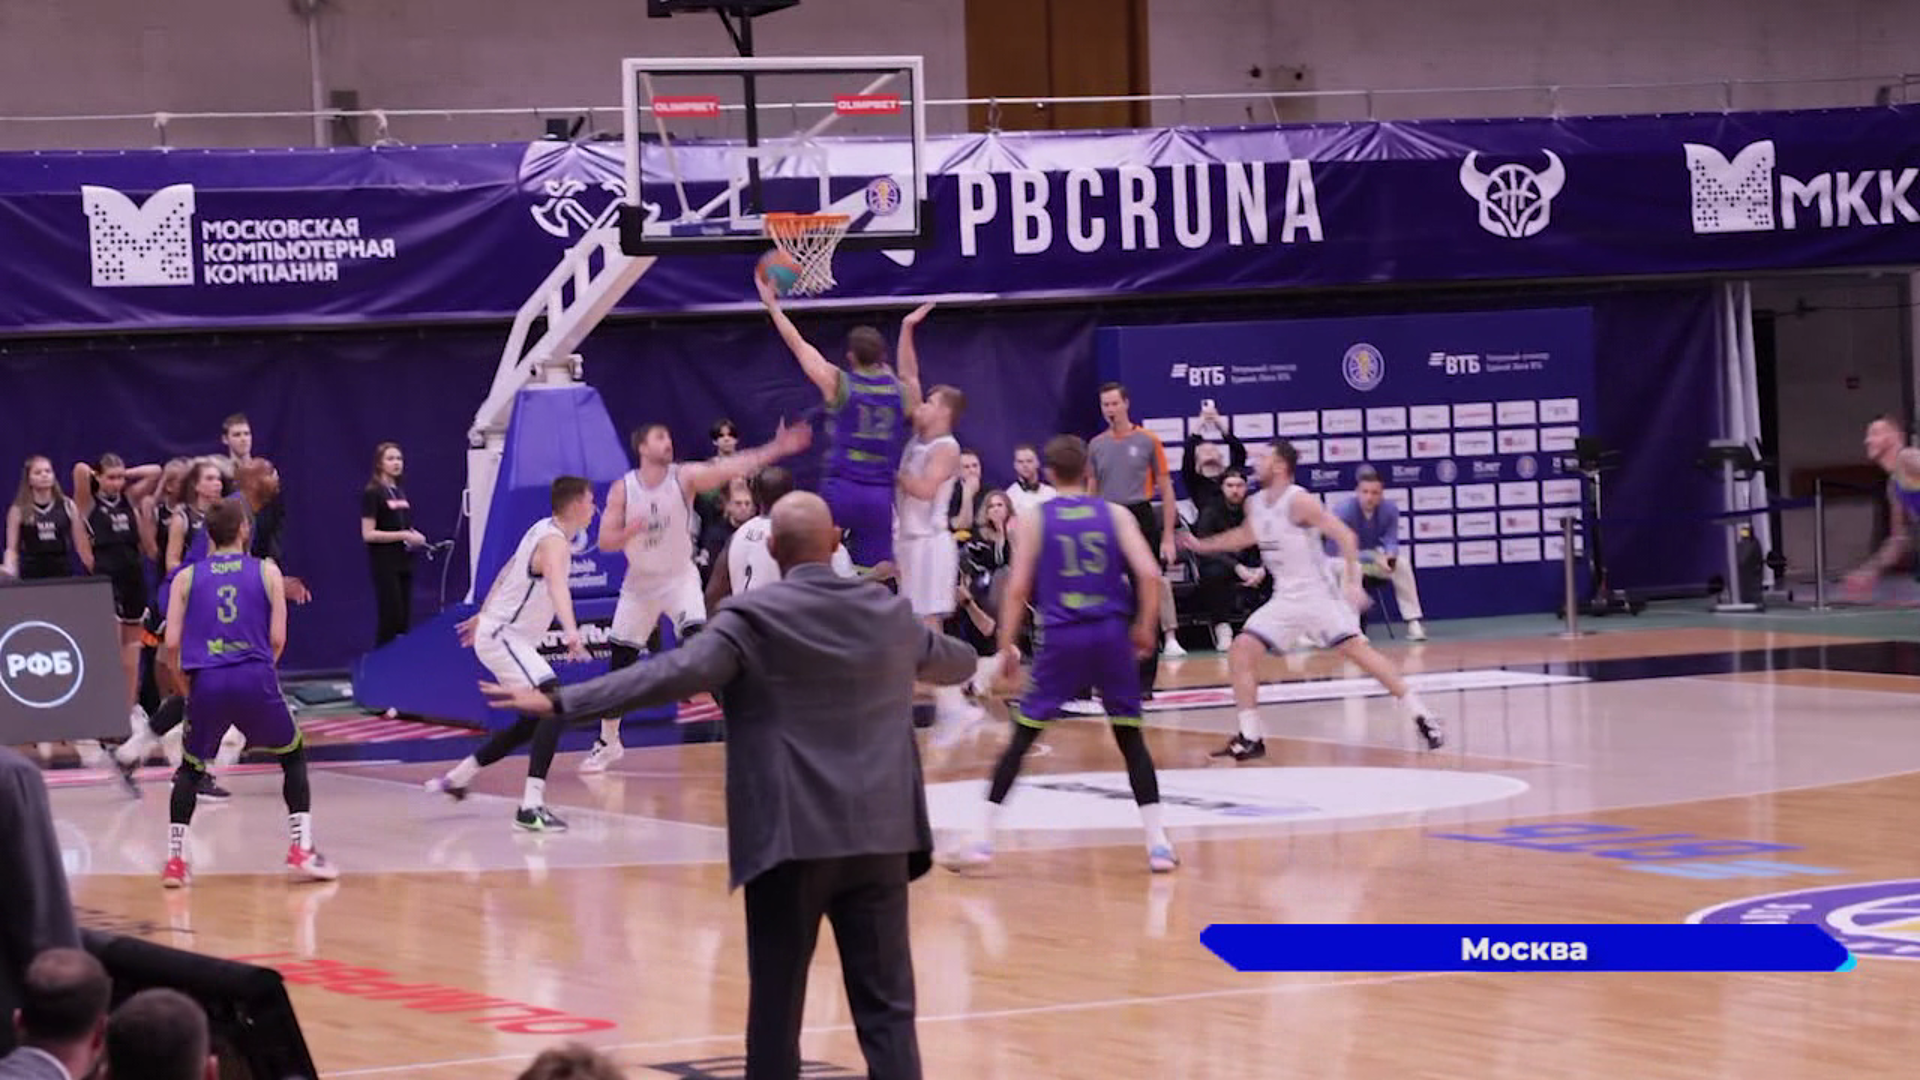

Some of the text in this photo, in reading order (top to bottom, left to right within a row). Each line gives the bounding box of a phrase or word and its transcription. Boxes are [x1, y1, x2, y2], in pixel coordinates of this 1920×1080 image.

[958, 159, 1324, 256] PBCRUNA
[201, 217, 360, 240] МОСКОВСКАЯ
[203, 238, 396, 262] КОМПЬЮТЕРНАЯ
[204, 261, 338, 285] КОМПАНИЯ
[1188, 366, 1226, 387] ВТБ
[1445, 354, 1481, 375] ВТБ
[1056, 531, 1108, 577] 15
[216, 585, 238, 625] 3
[6, 650, 73, 678] РФБ
